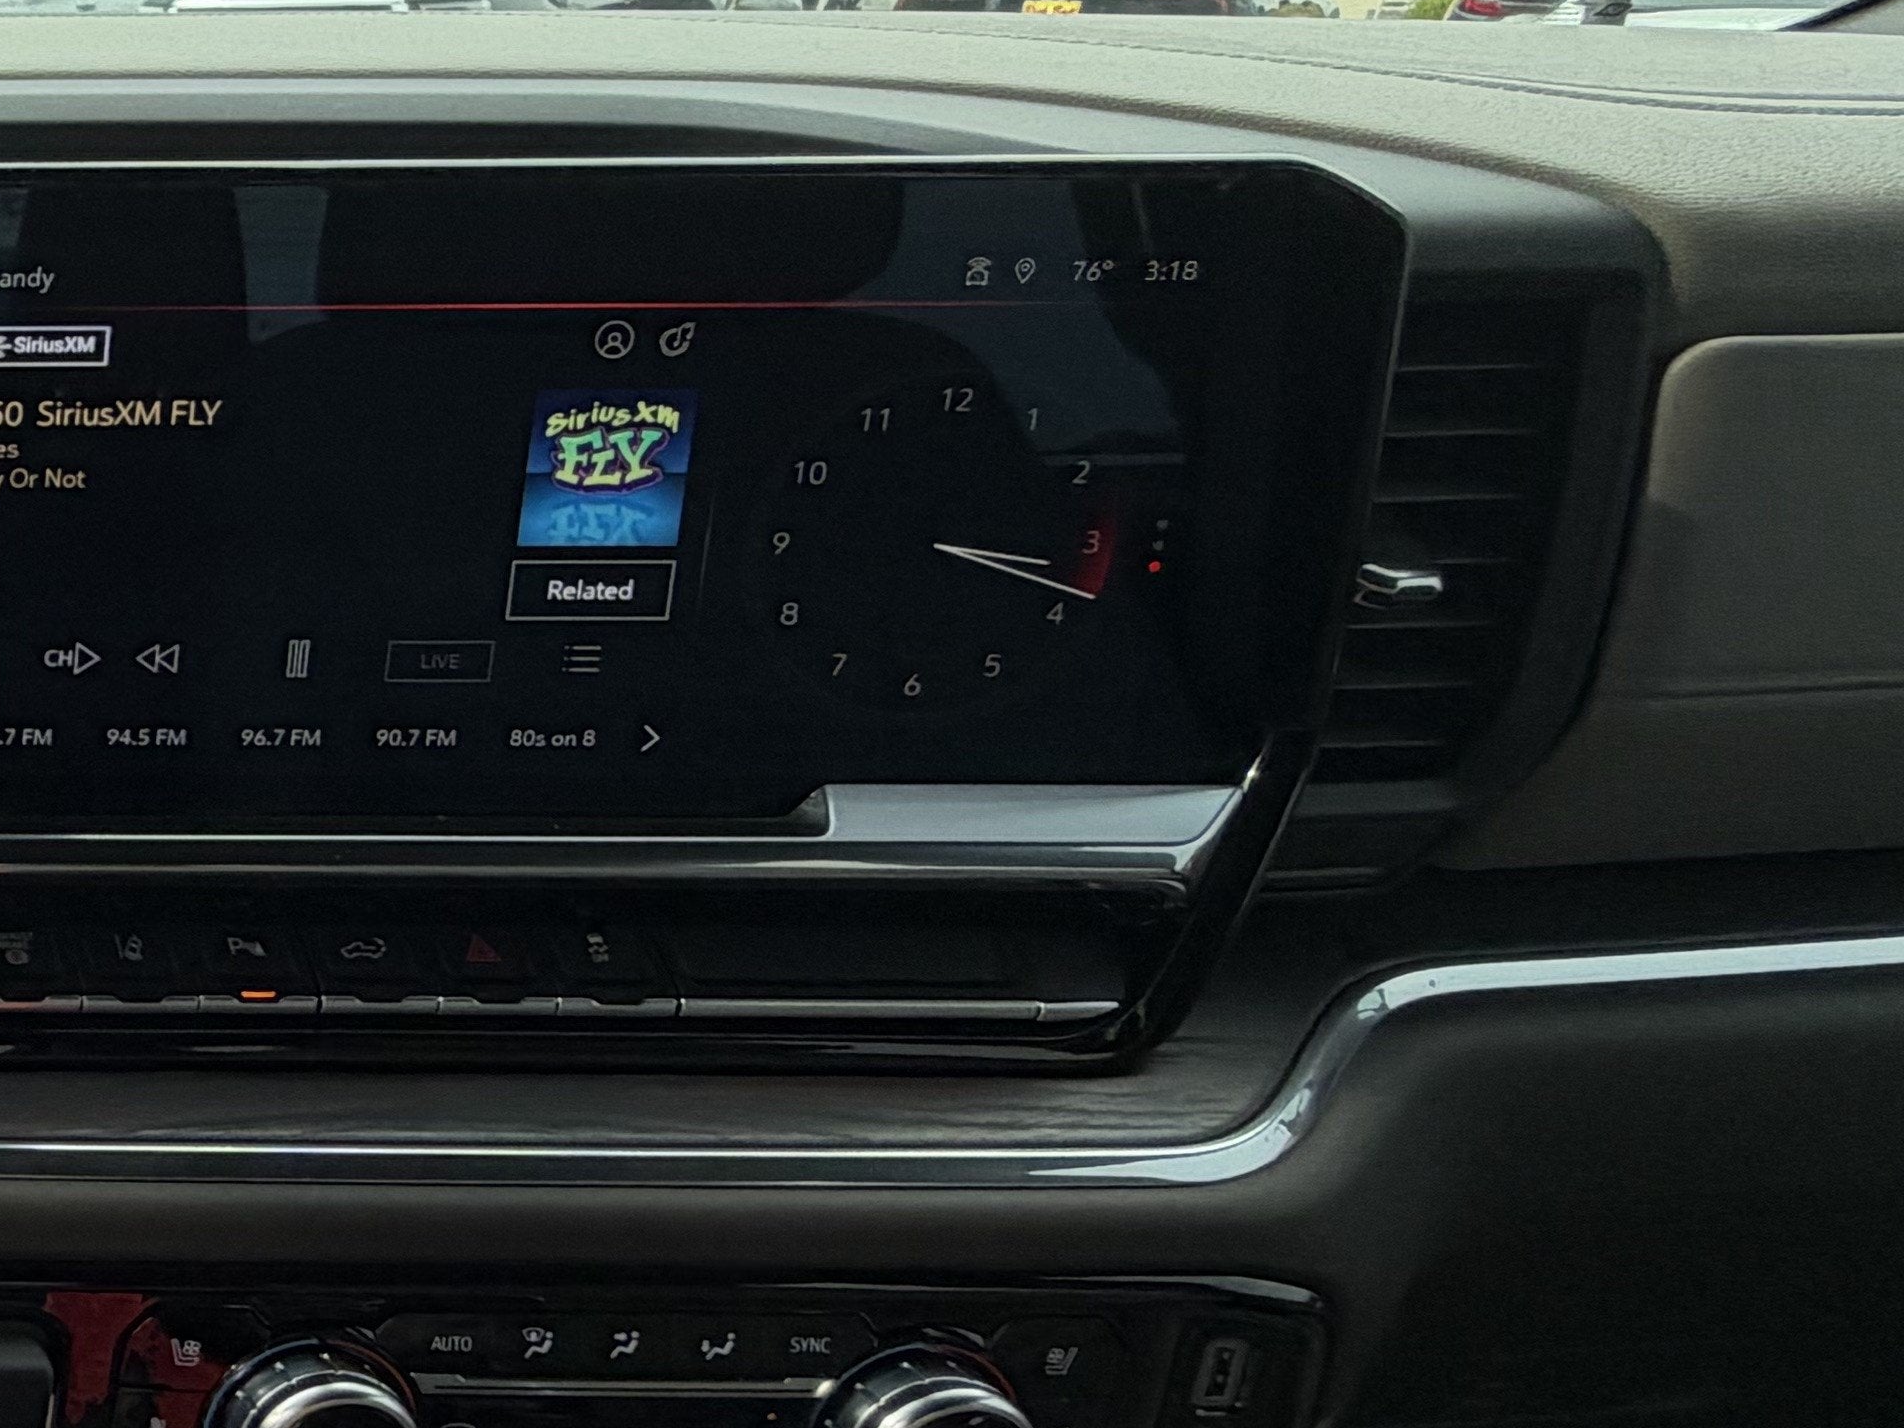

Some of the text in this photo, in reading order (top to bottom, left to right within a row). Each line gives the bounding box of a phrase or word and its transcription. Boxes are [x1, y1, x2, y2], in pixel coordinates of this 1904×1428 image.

[1072, 259, 1117, 283] 76°
[1143, 259, 1200, 283] 3:18
[13, 335, 97, 356] SiriusXM
[940, 387, 975, 413] 12
[36, 399, 163, 428] SiriusXM
[169, 399, 224, 427] FLY
[860, 407, 893, 433] 11
[1026, 407, 1041, 431] 1
[555, 429, 667, 487] FLY
[8, 469, 40, 490] Or
[44, 469, 87, 491] Not
[794, 460, 829, 486] 10
[1071, 459, 1093, 485] 2
[772, 531, 792, 556] 9
[1081, 529, 1102, 554] 3
[545, 579, 636, 602] Related
[779, 601, 800, 627] 8
[1045, 601, 1066, 626] 4
[43, 648, 75, 669] CH
[419, 653, 461, 671] LIVE
[831, 652, 849, 678] 7
[982, 652, 1003, 679] 5
[902, 672, 923, 699] 6
[20, 728, 54, 747] FM
[105, 728, 188, 748] 94.5 FM
[240, 728, 323, 748] 96.7 FM
[375, 728, 458, 748] 90.7 FM
[508, 728, 598, 748] 80s on 8
[430, 1335, 474, 1354] AUTO
[789, 1336, 832, 1355] SYNC
